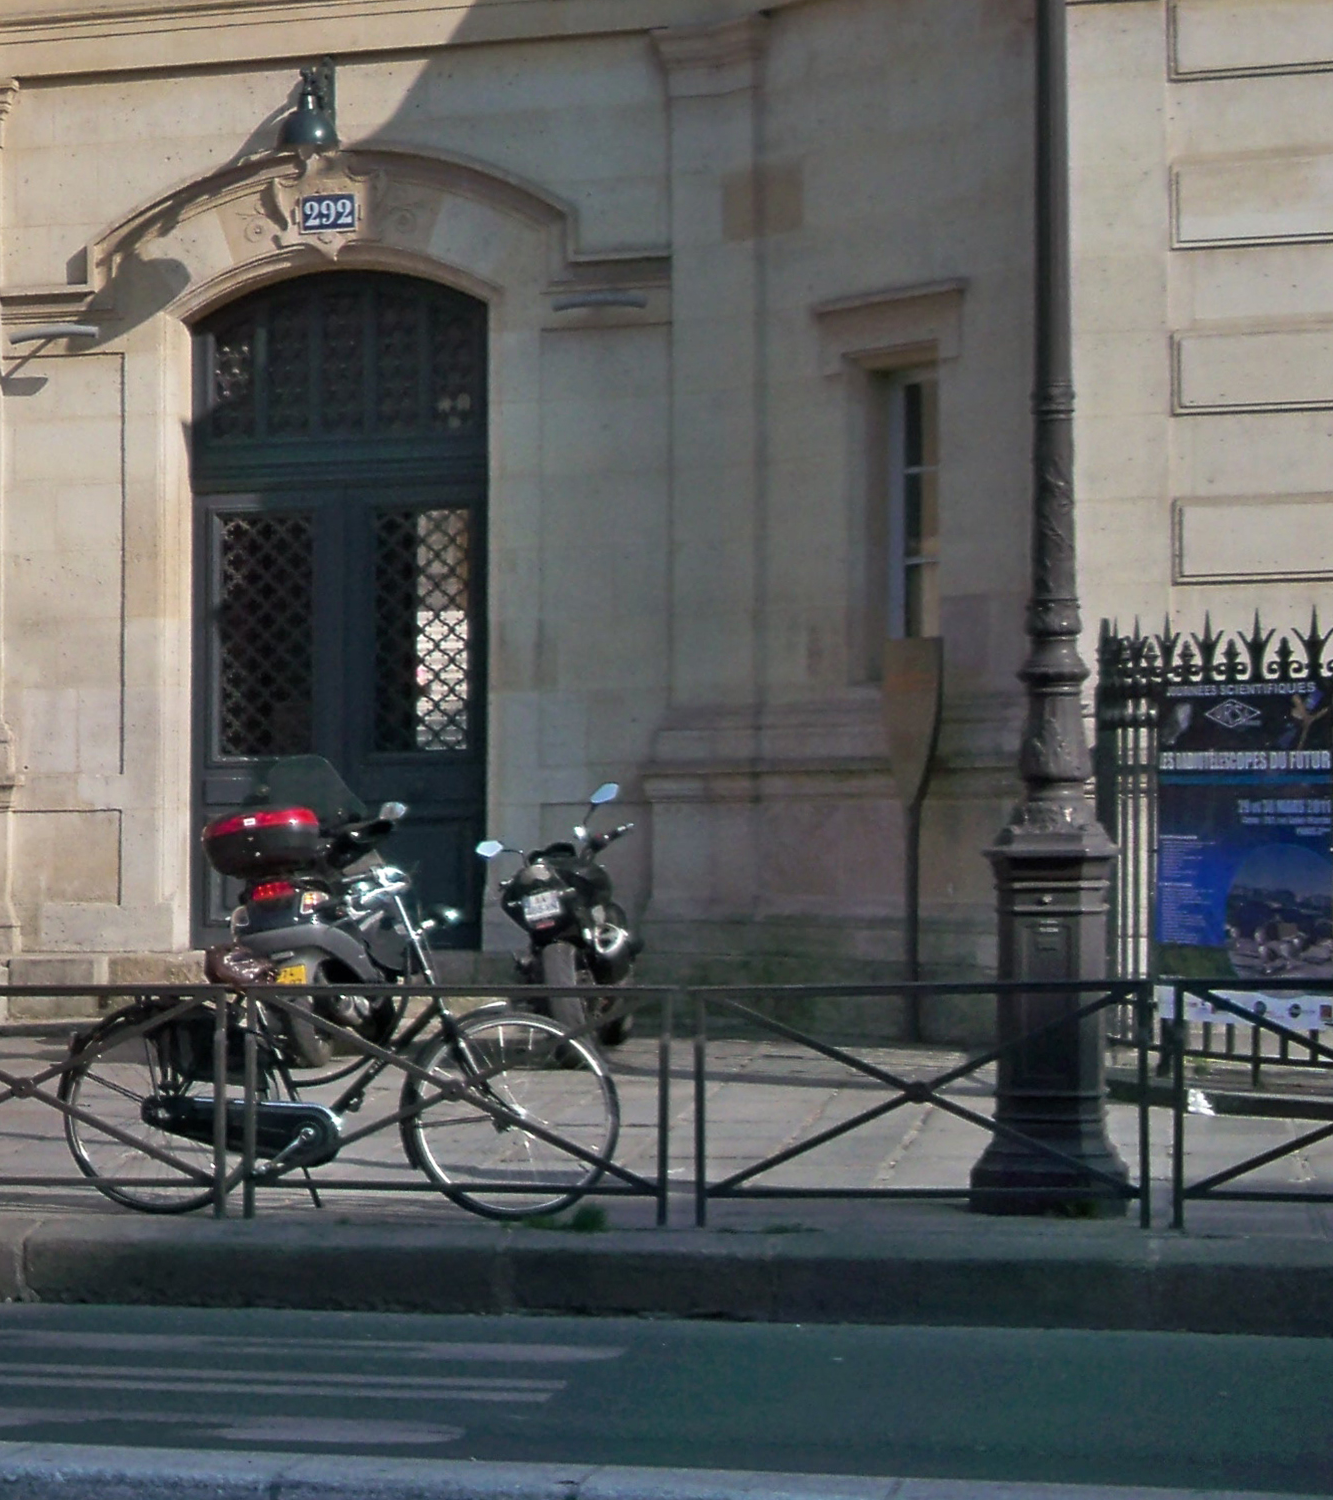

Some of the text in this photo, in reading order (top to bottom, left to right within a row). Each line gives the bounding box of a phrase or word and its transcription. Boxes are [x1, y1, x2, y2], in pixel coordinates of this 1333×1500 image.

[304, 199, 353, 226] 292
[1219, 681, 1317, 696] SCIENTIFIQUES
[1289, 750, 1331, 770] FUTUR
